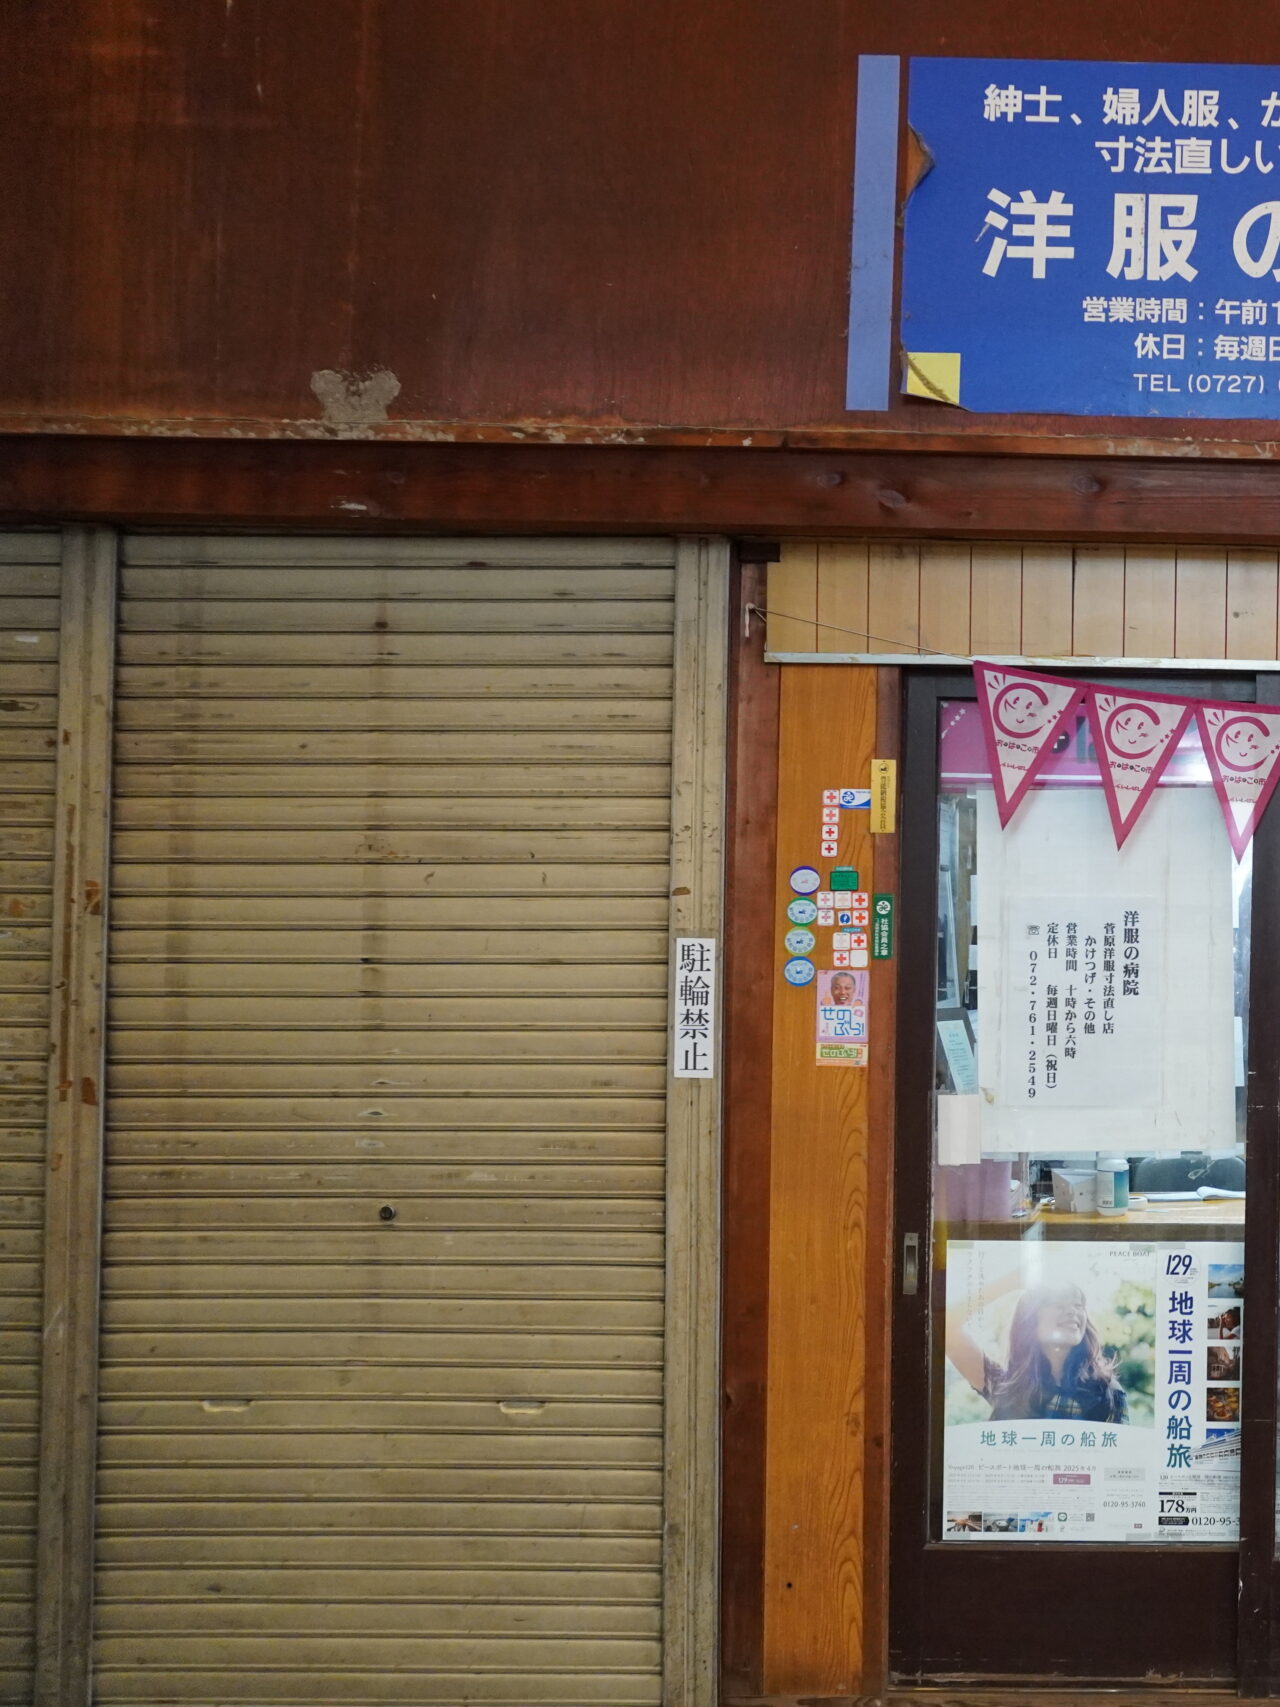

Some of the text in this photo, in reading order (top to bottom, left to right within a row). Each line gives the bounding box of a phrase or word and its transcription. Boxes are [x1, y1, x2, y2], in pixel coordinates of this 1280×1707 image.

[1133, 373, 1181, 393] TEL
[1187, 373, 1265, 395] (0727)
[1047, 922, 1060, 959] 定休日
[1102, 922, 1116, 1035] 菅原洋服寸法直し店
[1122, 910, 1140, 996] 洋服の病院
[679, 943, 711, 1072] 駐輪禁止
[1064, 922, 1078, 1059] 営業時間 十時から六時
[1166, 1254, 1193, 1276] 129
[1166, 1290, 1195, 1469] 地球一周の船旅
[980, 1430, 1118, 1448] 地球一周の船旅
